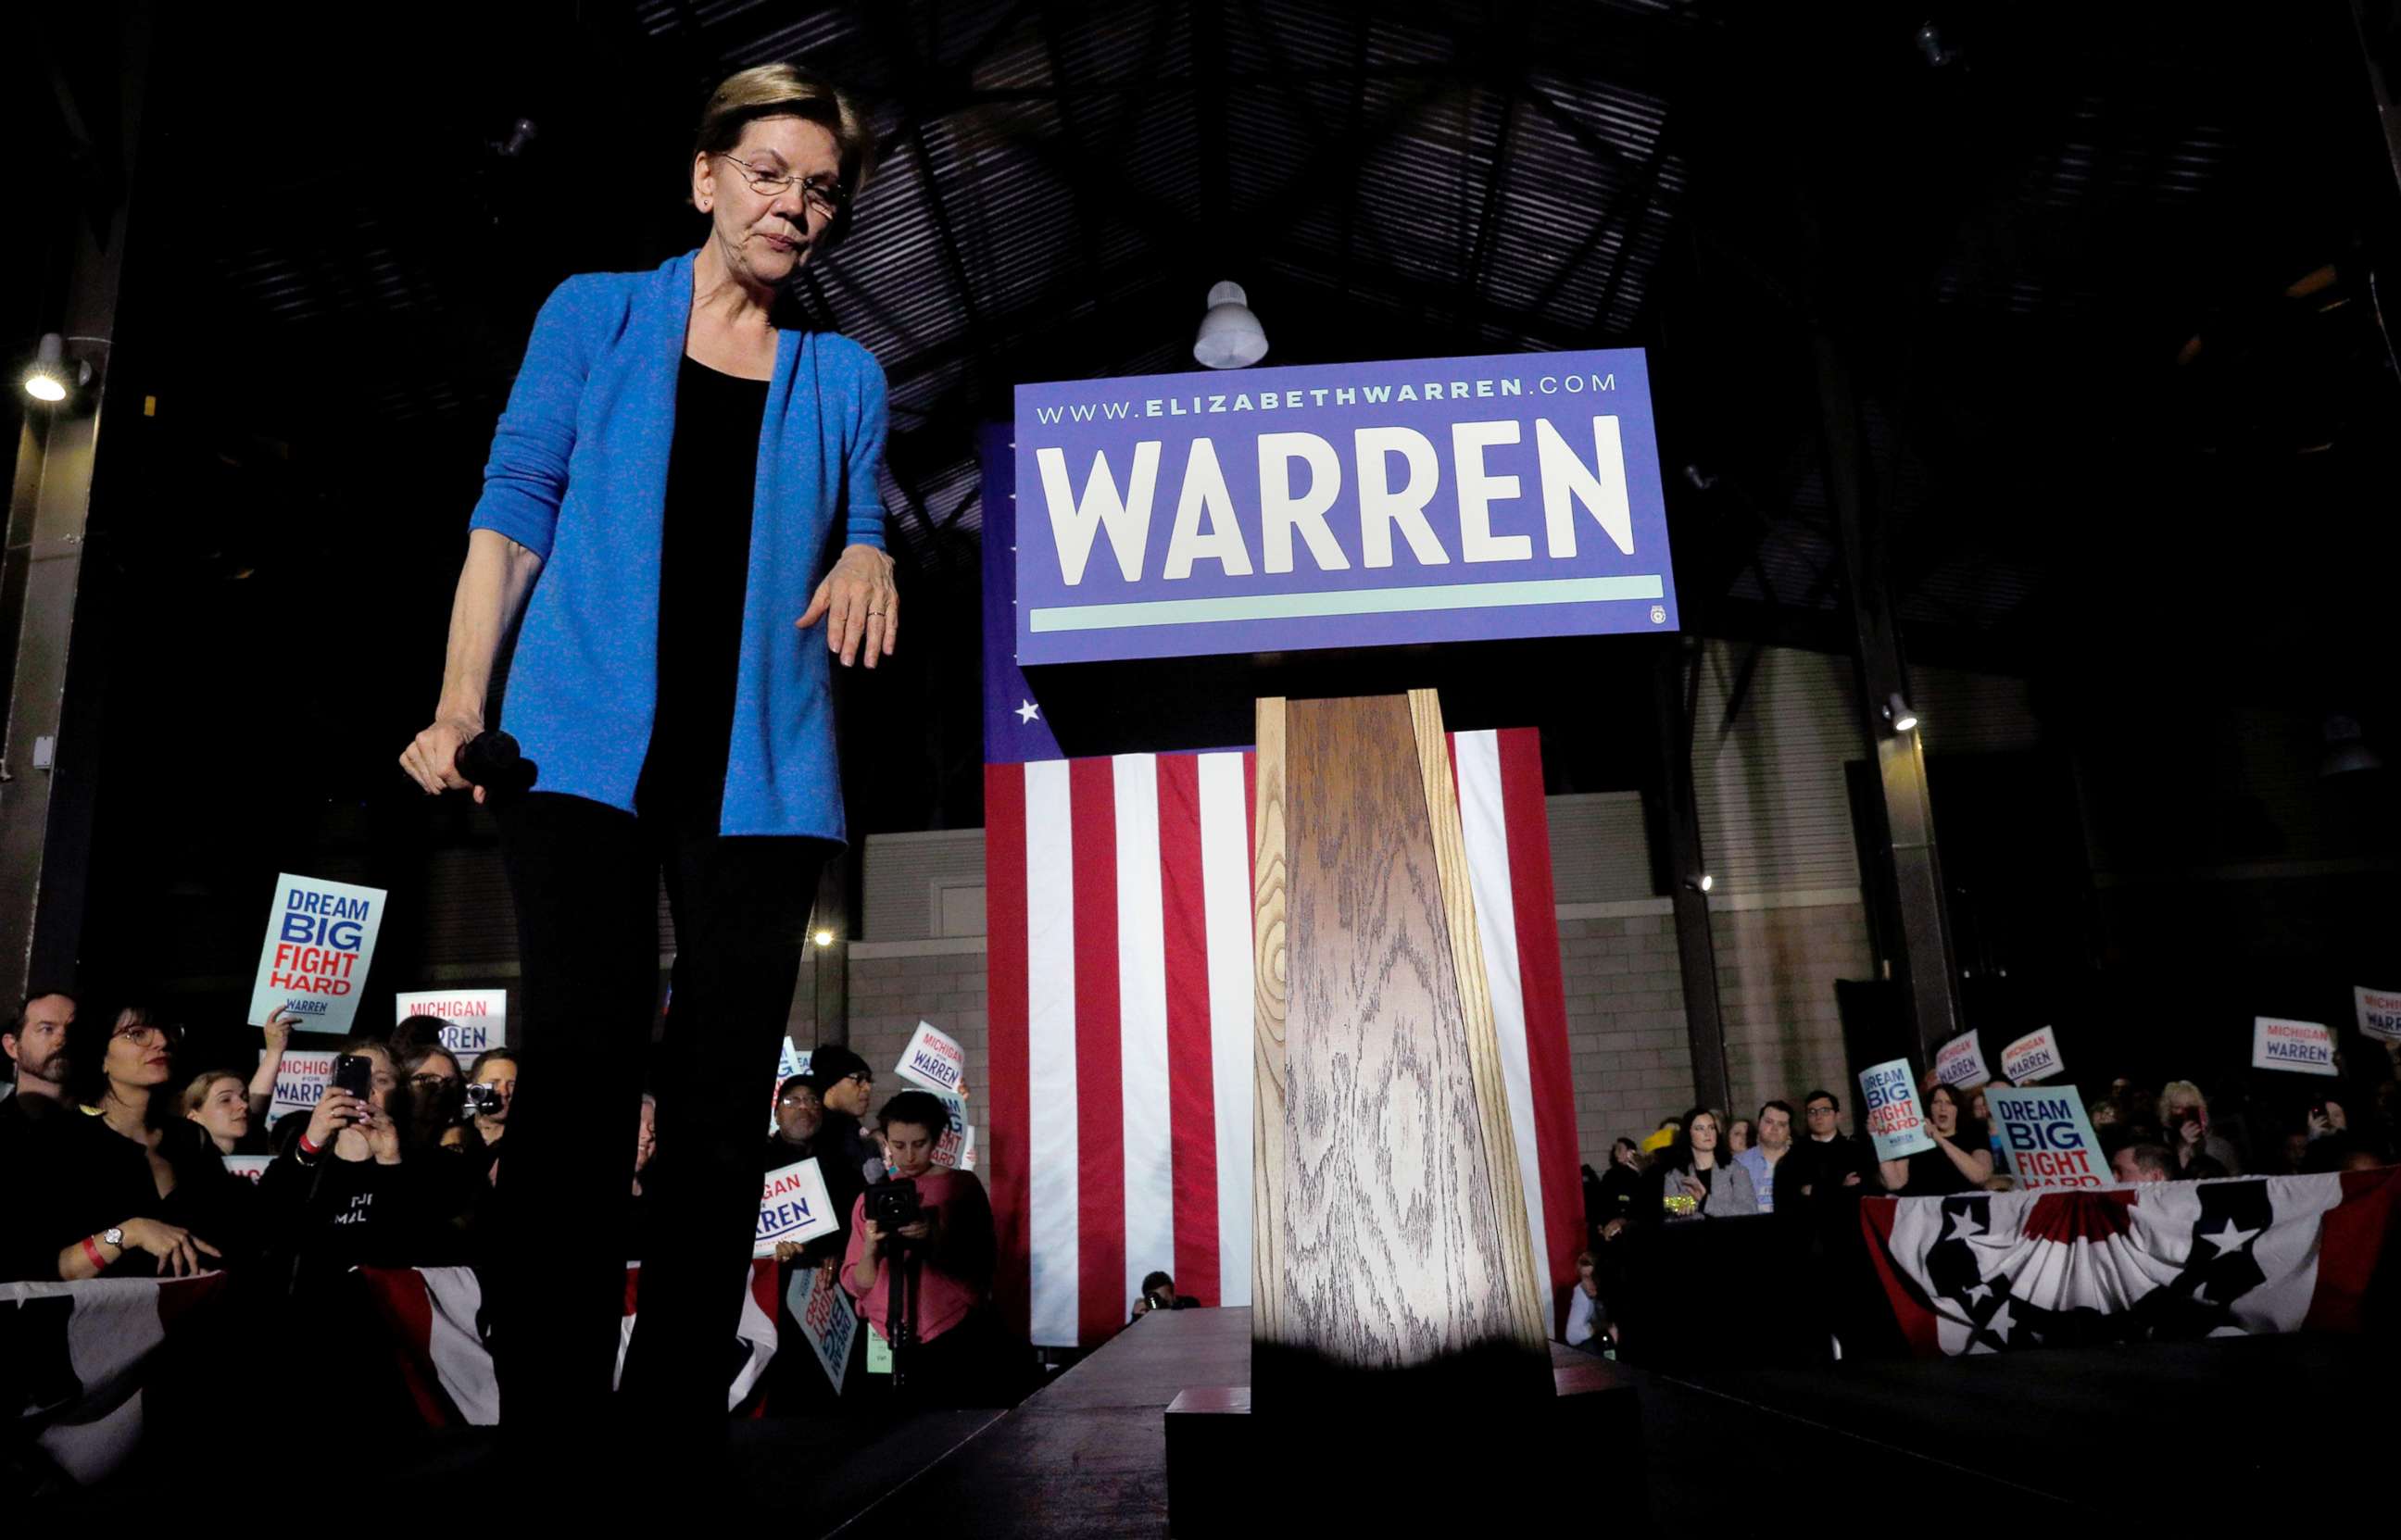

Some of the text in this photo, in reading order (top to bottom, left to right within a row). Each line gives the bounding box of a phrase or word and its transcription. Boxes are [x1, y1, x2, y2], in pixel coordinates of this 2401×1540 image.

[1037, 374, 1615, 424] WWW.ELIZABETHWARREN.COM
[1036, 415, 1635, 586] WARREN
[287, 889, 370, 921] DREAM
[280, 912, 364, 952] BIG
[273, 944, 358, 978] FIGHT
[270, 970, 352, 995] HARD
[285, 998, 328, 1012] WARREN
[410, 1001, 487, 1017] MICHIGAN
[2364, 995, 2401, 1009] MICHI
[2267, 1025, 2328, 1041] MICHIGAN
[2365, 1011, 2401, 1032] WARR
[440, 1026, 486, 1048] REN
[923, 1033, 962, 1063] MICHIGAN
[2007, 1049, 2051, 1077] WARREN
[2267, 1041, 2328, 1060] WARREN
[278, 1060, 333, 1074] MICHIG
[913, 1049, 960, 1084] WARREN
[1938, 1055, 1977, 1084] WARREN
[275, 1082, 323, 1102] WARR
[1864, 1068, 1904, 1091] DREAM
[1867, 1083, 1911, 1109] BIG
[1870, 1100, 1914, 1126] FIGHT
[1998, 1099, 2072, 1121] DREAM
[937, 1130, 962, 1154] GHT
[2005, 1121, 2084, 1150] BIG
[930, 1149, 956, 1167] ARD
[2015, 1149, 2091, 1176] FIGHT
[755, 1197, 811, 1234] REN
